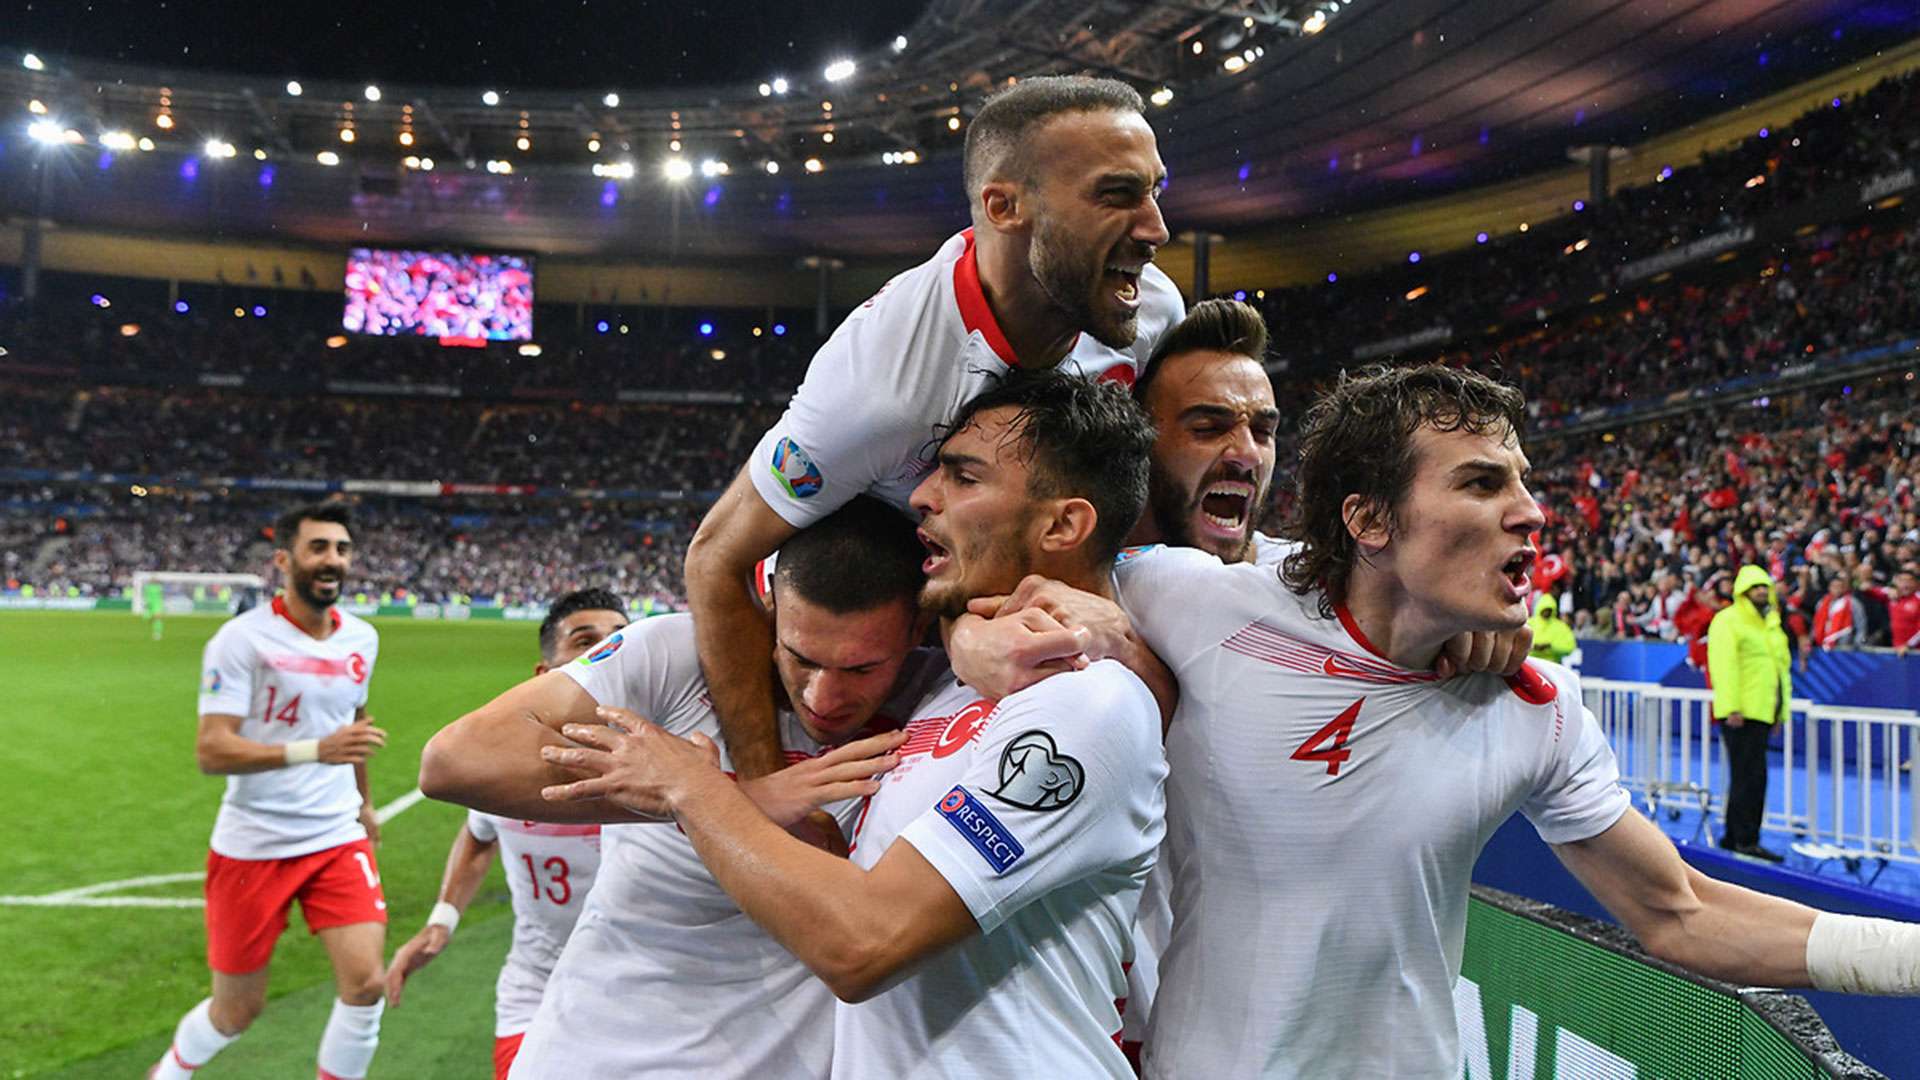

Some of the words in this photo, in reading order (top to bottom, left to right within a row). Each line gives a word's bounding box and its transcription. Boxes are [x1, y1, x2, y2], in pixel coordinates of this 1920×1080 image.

[262, 686, 302, 727] 14
[1289, 695, 1367, 776] 4
[955, 804, 1017, 864] RESPECT
[521, 853, 571, 906] 13
